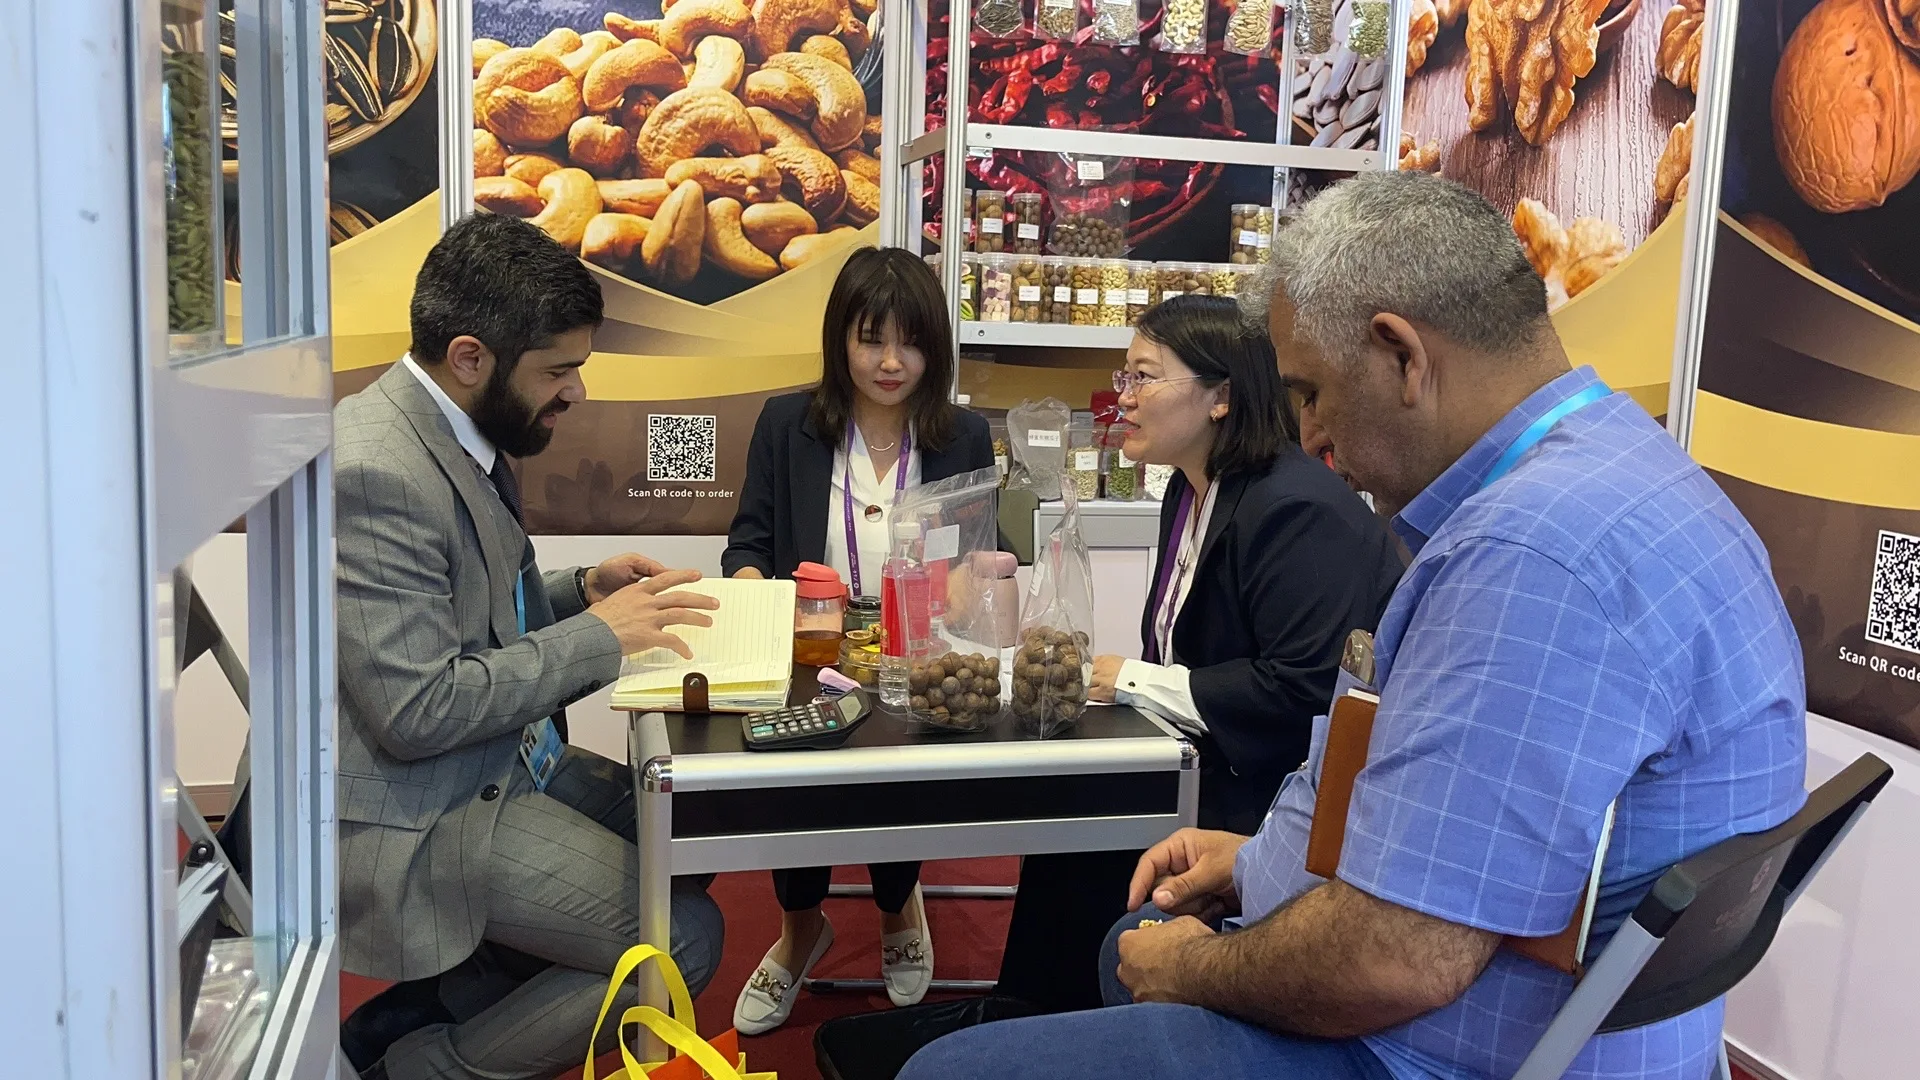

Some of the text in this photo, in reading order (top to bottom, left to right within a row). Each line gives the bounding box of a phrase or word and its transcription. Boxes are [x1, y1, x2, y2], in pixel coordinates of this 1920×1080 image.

[628, 488, 734, 498] Scan QR code to order
[1838, 646, 1866, 667] Scan
[1869, 655, 1888, 673] QR
